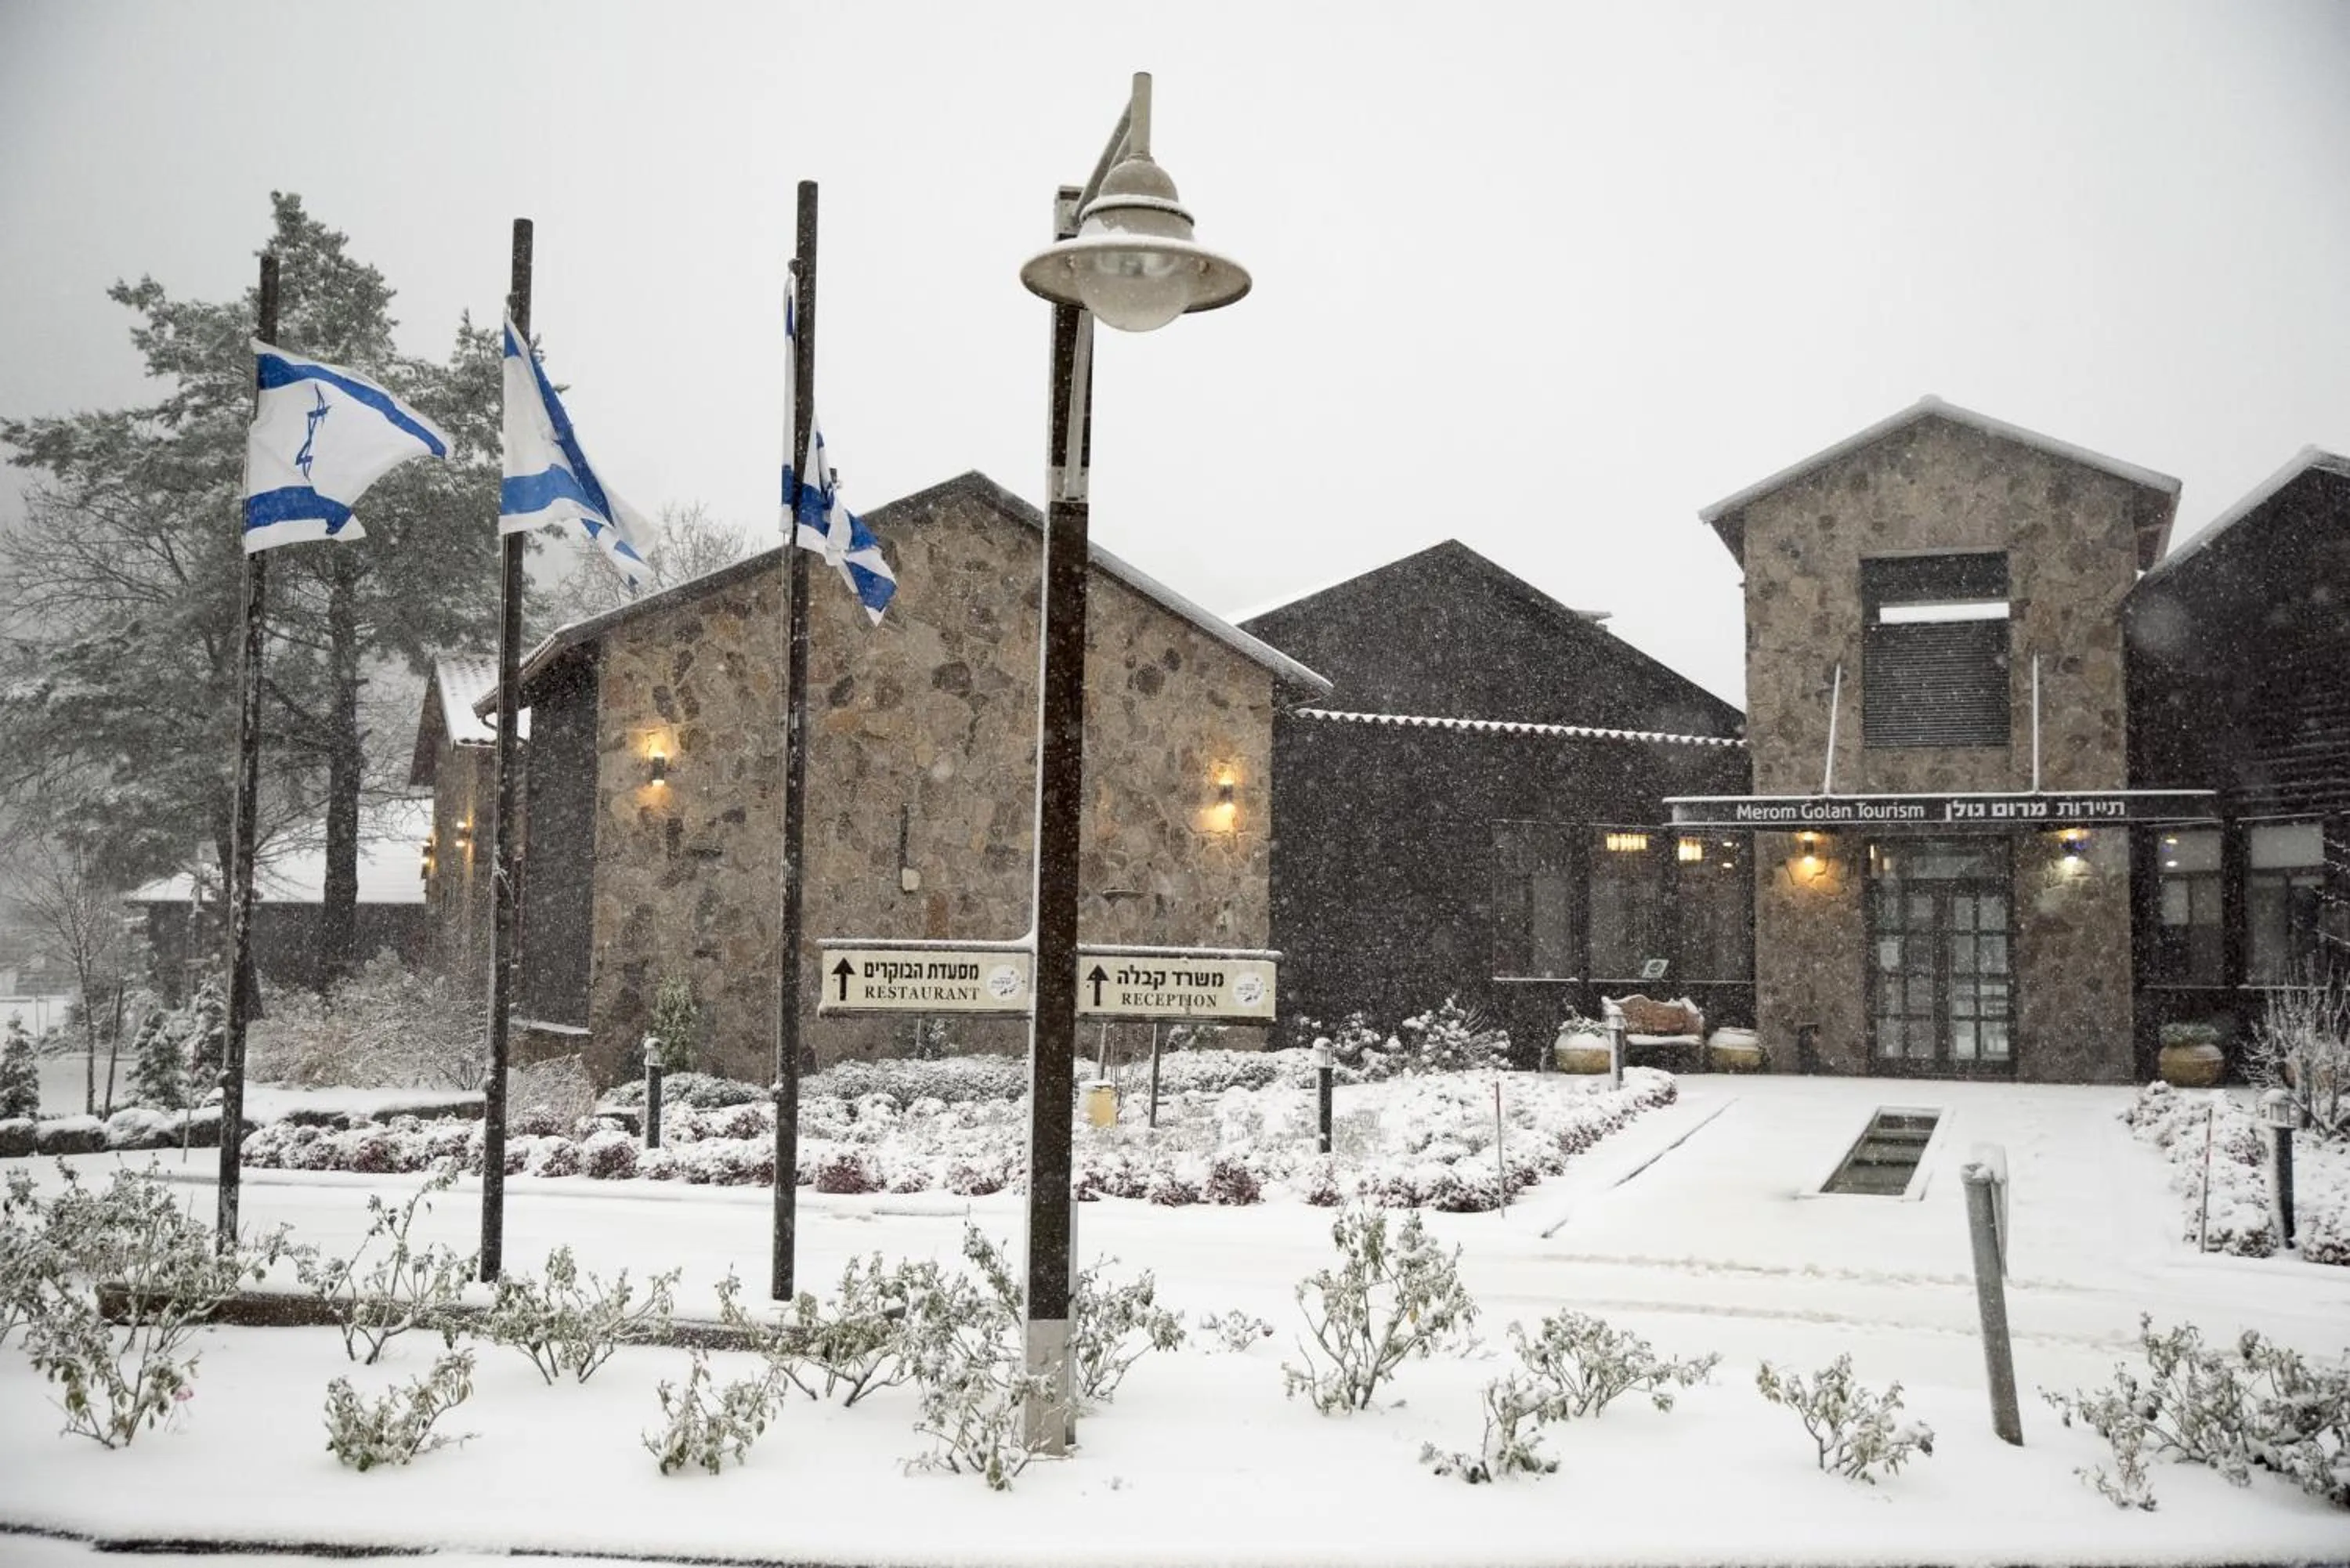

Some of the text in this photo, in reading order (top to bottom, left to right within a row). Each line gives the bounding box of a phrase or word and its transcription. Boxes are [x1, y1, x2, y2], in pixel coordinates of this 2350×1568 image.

[1736, 801, 1925, 820] Merom Golan Tourism
[1945, 800, 2126, 822] תיירות מרום גולן
[864, 962, 979, 984] מסעדת הבוקרים
[1117, 965, 1224, 990] משרד קבלה
[864, 985, 980, 1001] RESTAURANT
[1122, 992, 1217, 1008] RECEPTION
